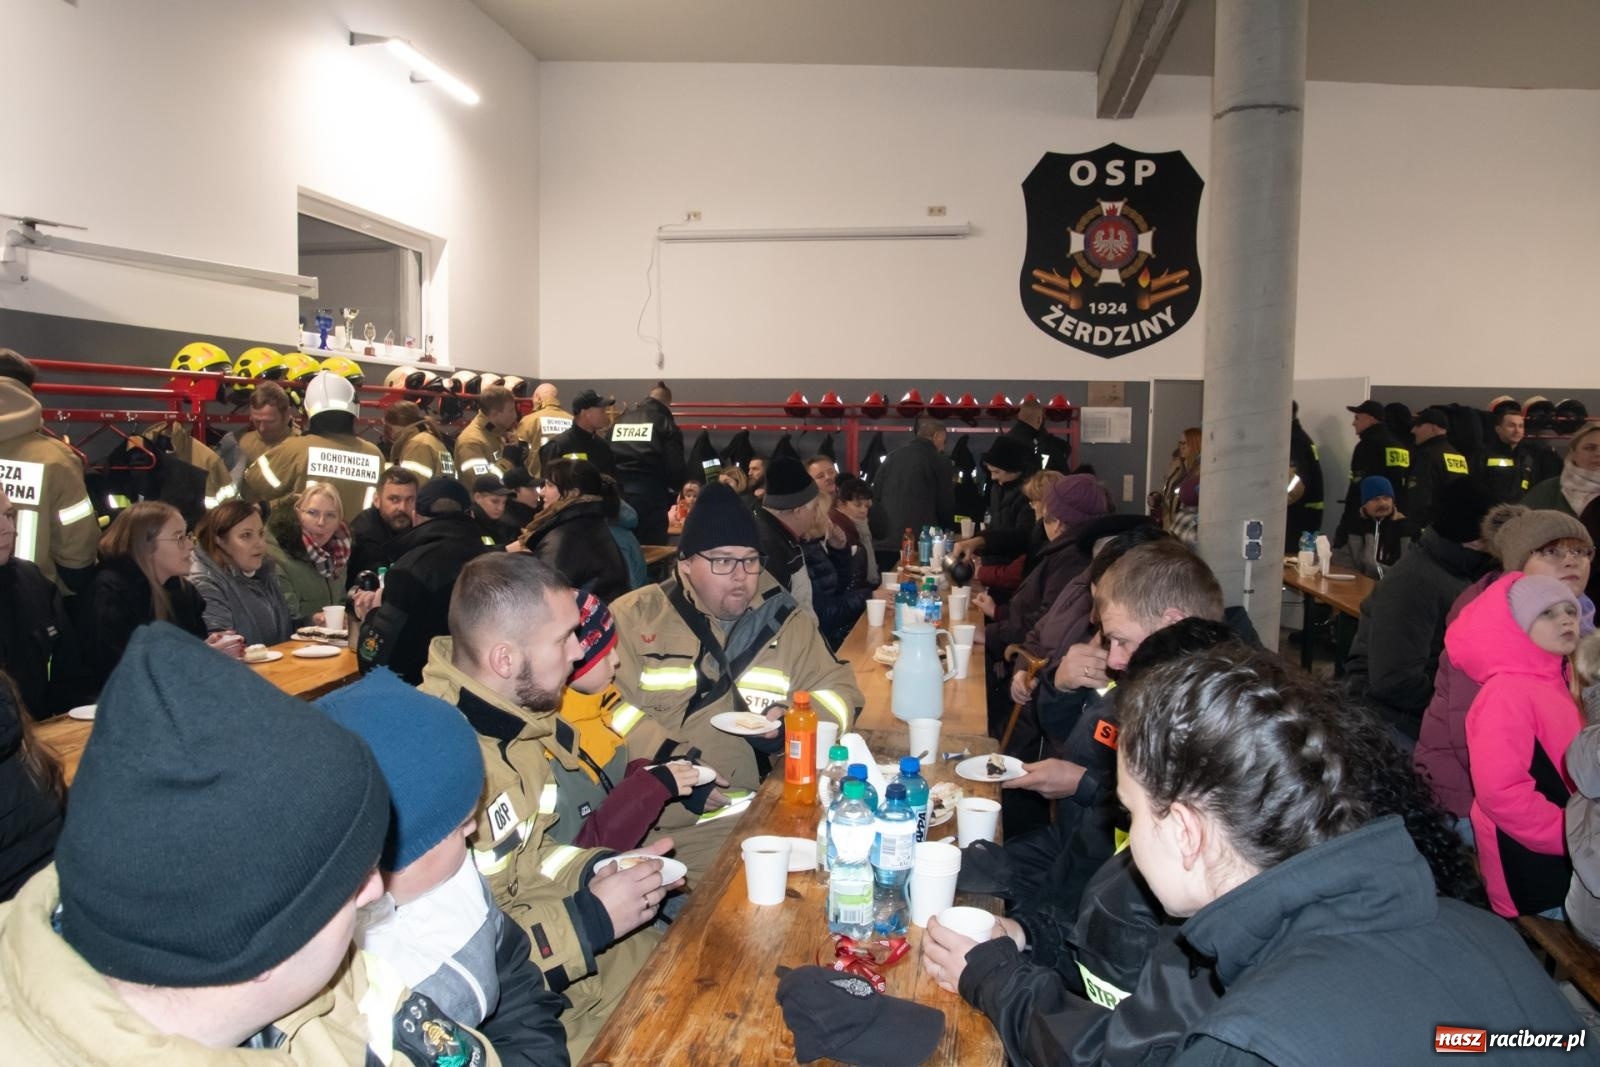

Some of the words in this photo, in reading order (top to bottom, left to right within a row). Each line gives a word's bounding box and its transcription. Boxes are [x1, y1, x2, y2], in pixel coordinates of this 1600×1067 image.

[1069, 159, 1156, 186] OSP
[1089, 302, 1128, 315] 1924
[1041, 304, 1176, 346] ŻERDZINY
[320, 452, 370, 467] OCHOTNICZA
[745, 695, 775, 708] STR
[494, 802, 511, 831] OSP
